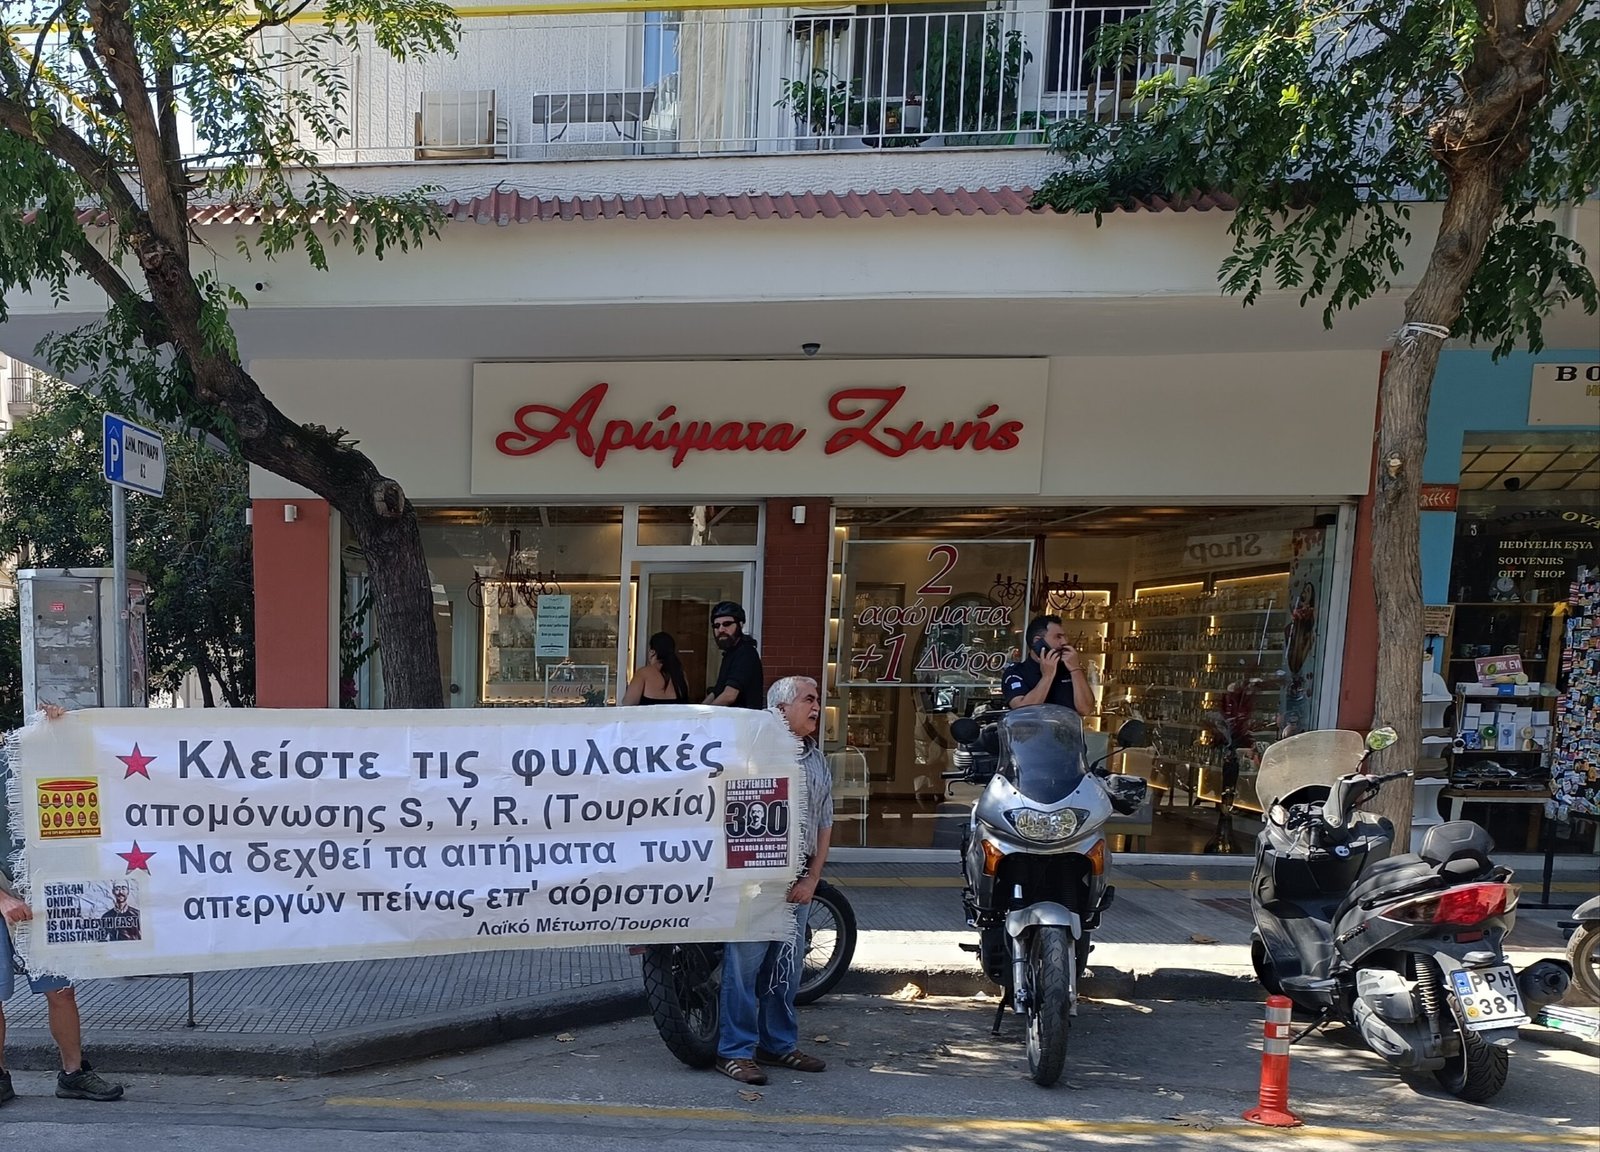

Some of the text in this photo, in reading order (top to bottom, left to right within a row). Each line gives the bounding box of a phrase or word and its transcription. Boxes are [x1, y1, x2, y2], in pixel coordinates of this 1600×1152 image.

[495, 382, 1024, 469] Αρώματα Ζωής
[110, 437, 119, 473] P
[1564, 541, 1594, 551] EŞYA
[916, 543, 959, 596] 2
[1498, 556, 1564, 566] SOUVENIRS
[1498, 569, 1566, 578] GIFT SHOP
[858, 598, 1013, 635] αρώματα
[179, 733, 724, 789] Κλείστε τις φυλακές
[737, 779, 772, 789] SEPTEMBER
[125, 797, 385, 833] απομόνωσης
[543, 785, 716, 829] (Τουρκία)
[178, 836, 714, 878] Να δεχθεί τα αιτήματα των
[45, 884, 84, 896] SERKAN
[184, 884, 345, 924] απεργών
[357, 881, 475, 918] πείνας
[548, 876, 714, 912] αόριστον!
[46, 896, 73, 908] ONUR
[46, 907, 82, 919] YILMAZ
[60, 919, 73, 931] ON
[83, 918, 113, 930] DEATH
[477, 917, 530, 935] Λαϊκό
[48, 930, 108, 943] RESISTANCE
[1471, 970, 1514, 992] PPM
[1479, 994, 1518, 1016] 387
